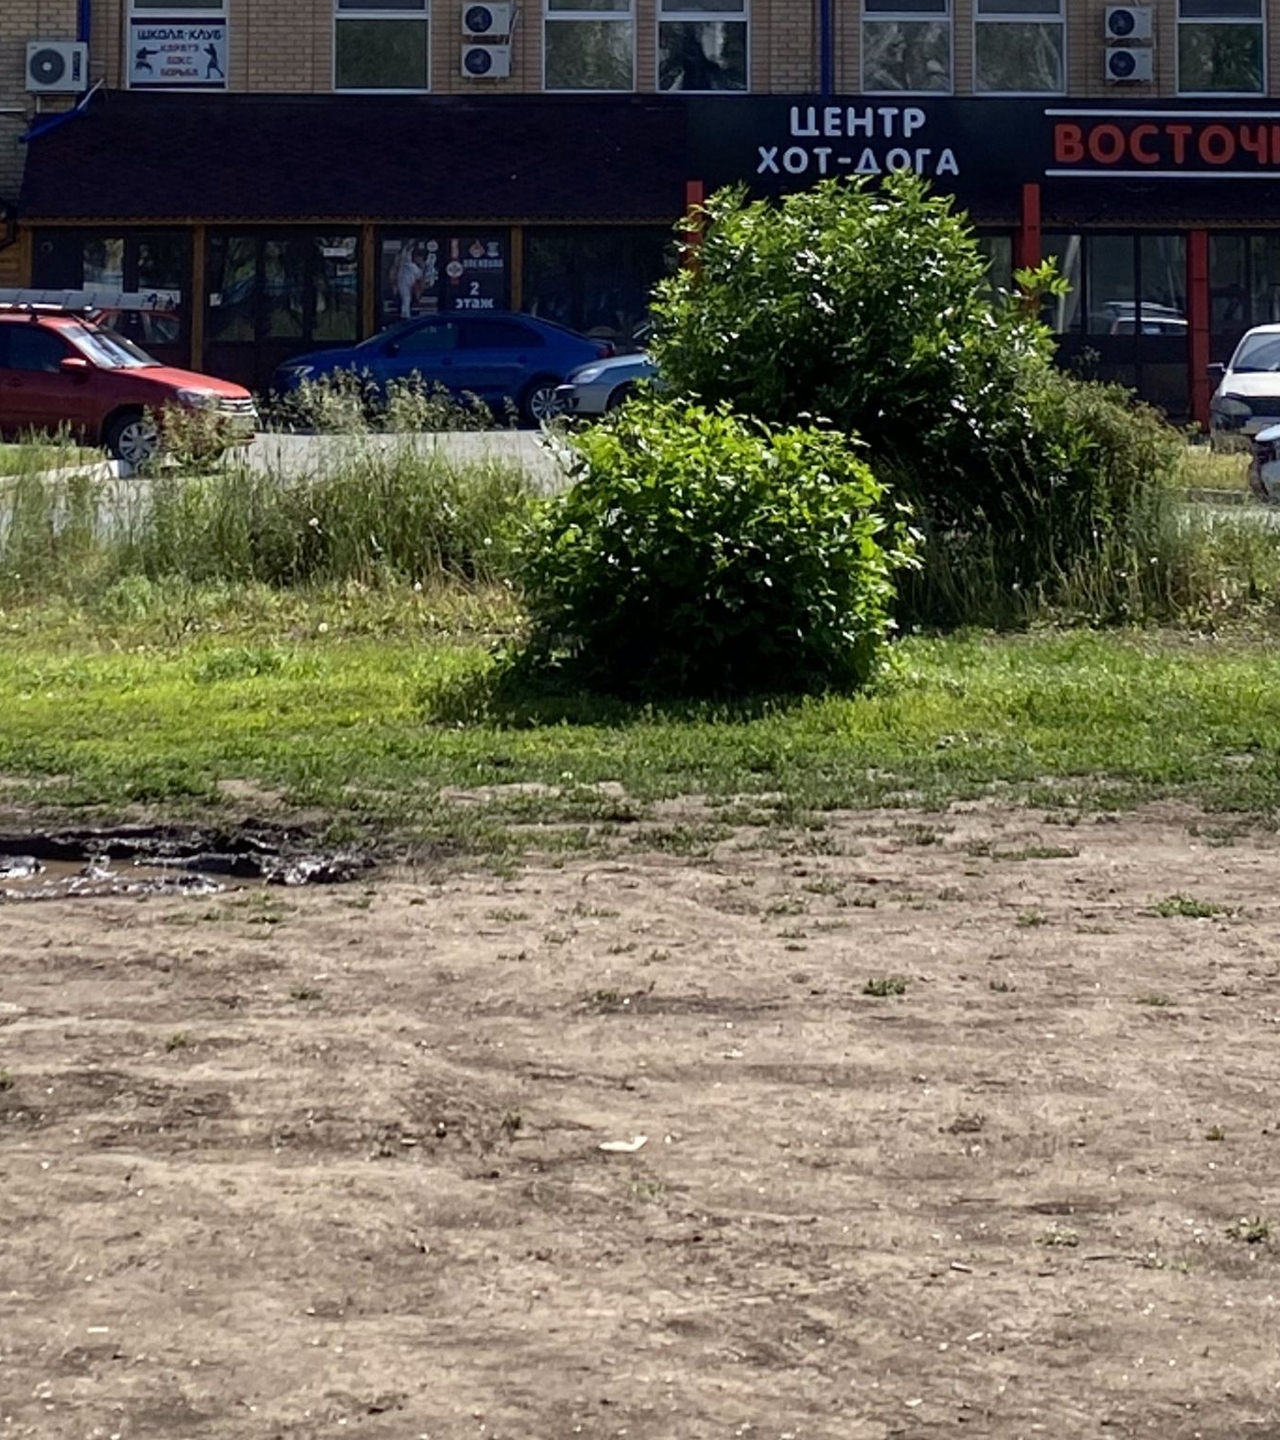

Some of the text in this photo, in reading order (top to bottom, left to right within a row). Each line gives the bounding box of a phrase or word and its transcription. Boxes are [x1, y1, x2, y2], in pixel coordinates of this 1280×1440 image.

[790, 106, 926, 137] ЦЕНТР
[756, 146, 960, 175] ХОТ-ДОГА
[470, 281, 479, 295] 2
[456, 298, 494, 309] этаж
